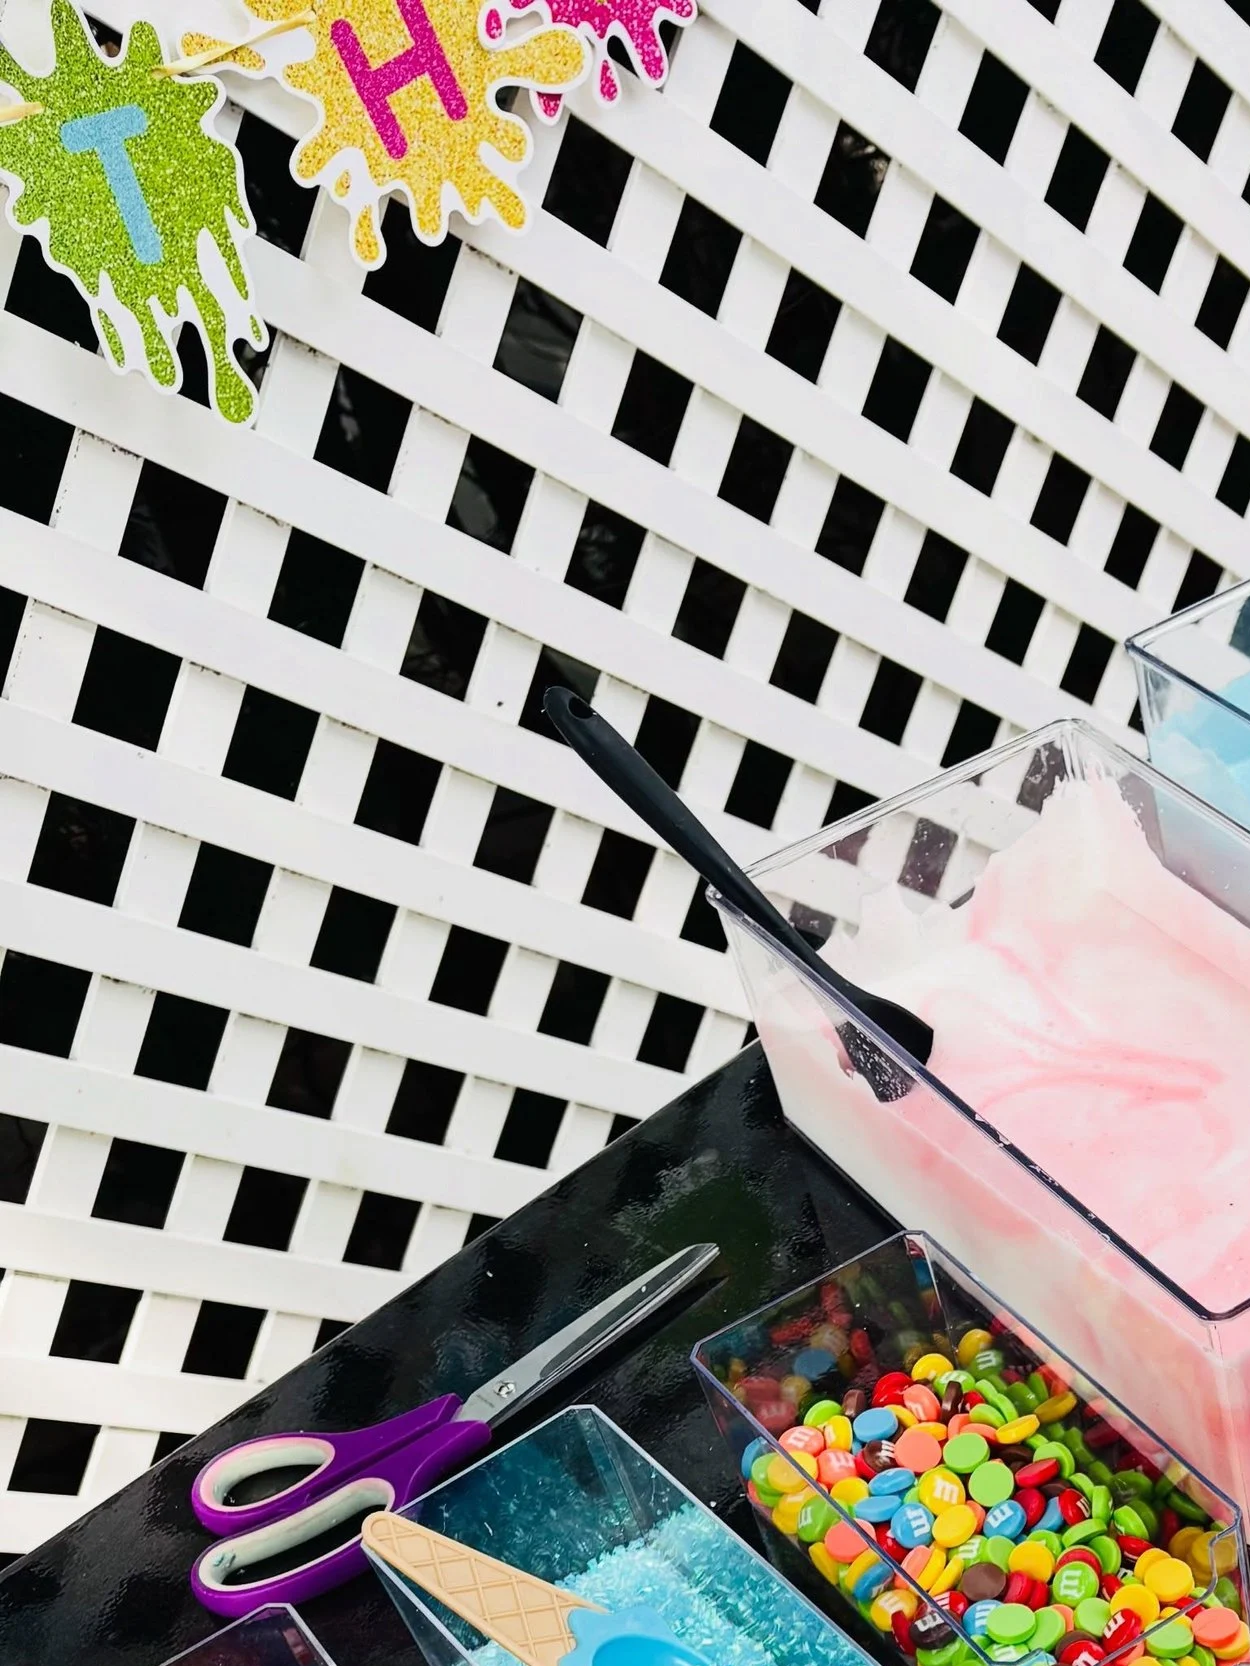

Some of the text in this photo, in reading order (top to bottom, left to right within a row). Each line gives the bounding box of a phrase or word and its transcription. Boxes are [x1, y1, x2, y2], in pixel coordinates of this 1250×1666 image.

[61, 0, 468, 264] T H
[976, 1350, 996, 1370] m
[787, 1428, 814, 1447] m
[829, 1451, 854, 1468] m
[934, 1477, 959, 1504] m
[799, 1507, 813, 1526] m
[906, 1504, 931, 1536] m
[987, 1502, 1014, 1528] m
[958, 1538, 980, 1560] m
[1060, 1569, 1084, 1598] m
[880, 1594, 905, 1613] m
[975, 1603, 996, 1627] m
[914, 1612, 944, 1632] m
[1103, 1612, 1126, 1639] m
